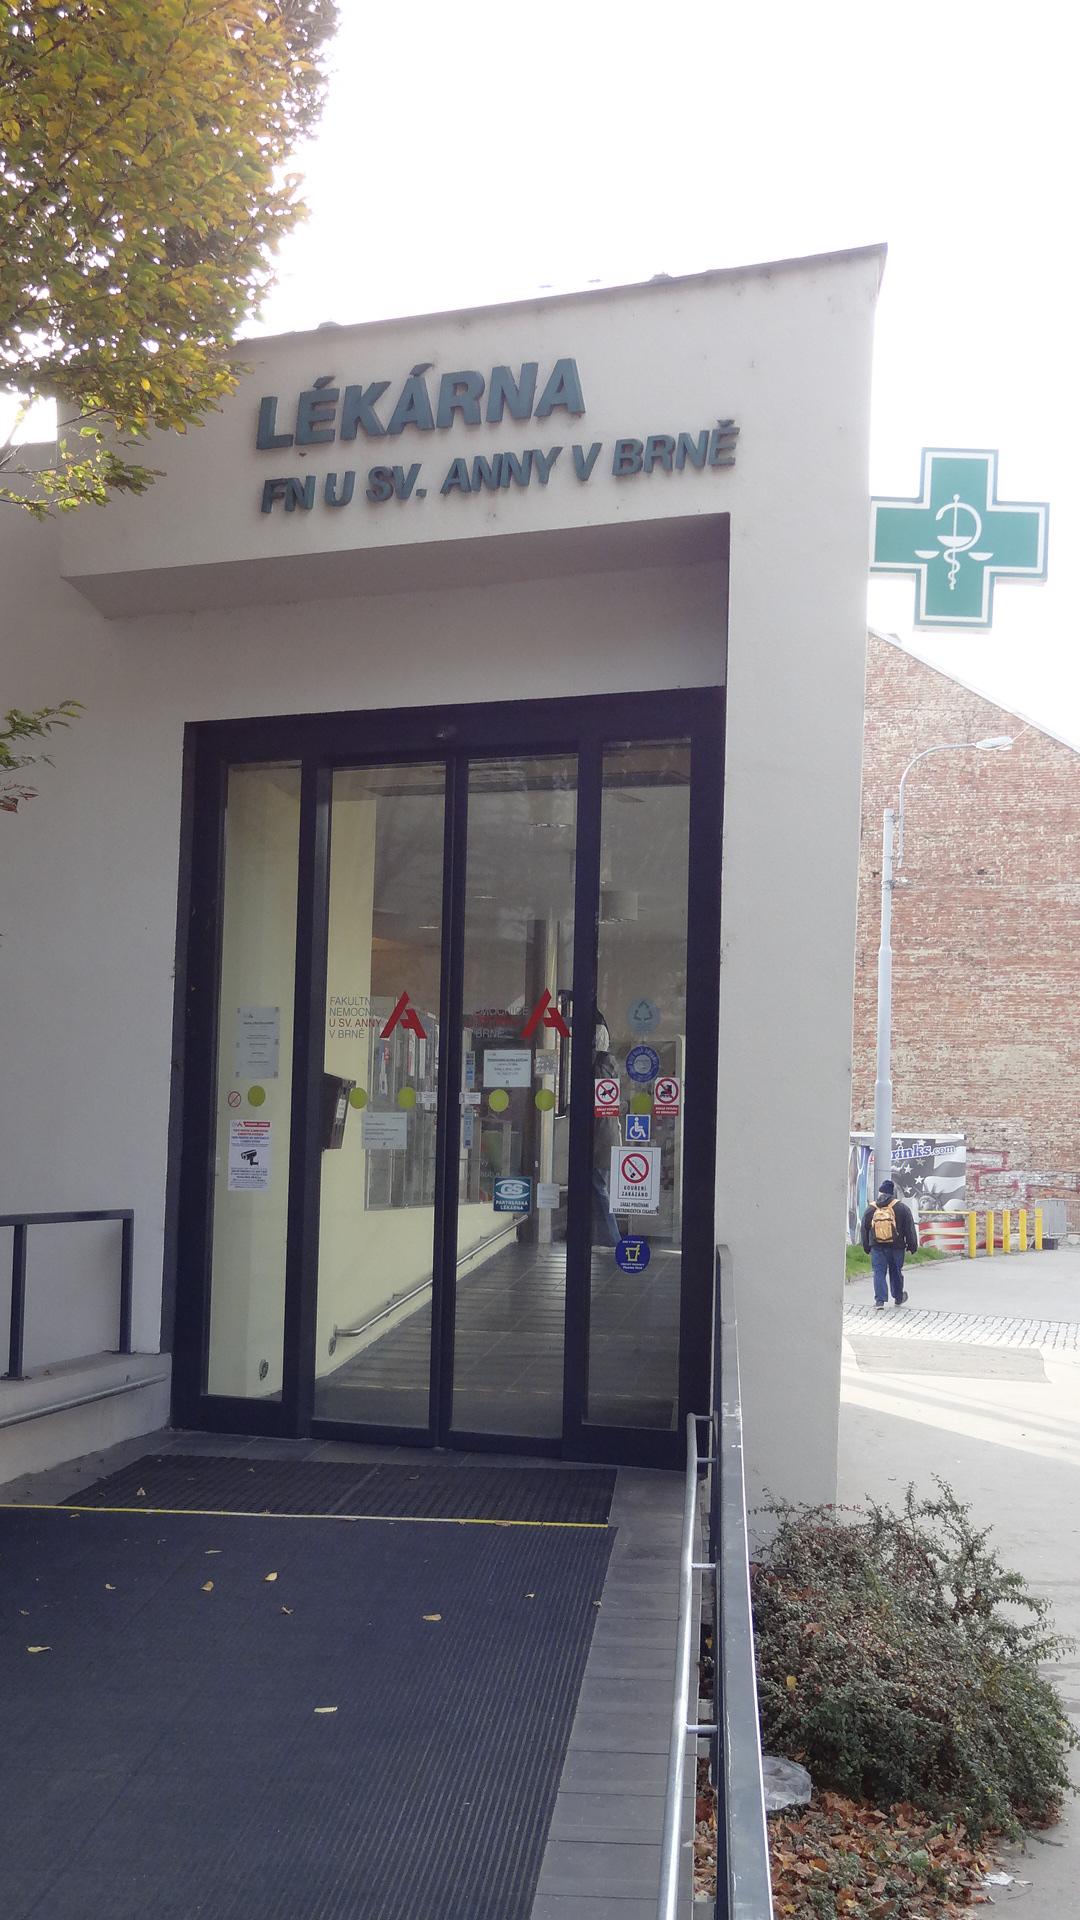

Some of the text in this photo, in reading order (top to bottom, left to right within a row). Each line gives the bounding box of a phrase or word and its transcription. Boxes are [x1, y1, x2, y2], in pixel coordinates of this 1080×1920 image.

[256, 358, 586, 450] LÉKÁRNA
[261, 418, 741, 513] FN U SV. ANNY V BRNĚ
[329, 996, 375, 1006] FAKULTN
[329, 1018, 382, 1028] U SV. ANNY
[328, 1029, 336, 1038] V
[891, 1144, 956, 1161] rinks.com
